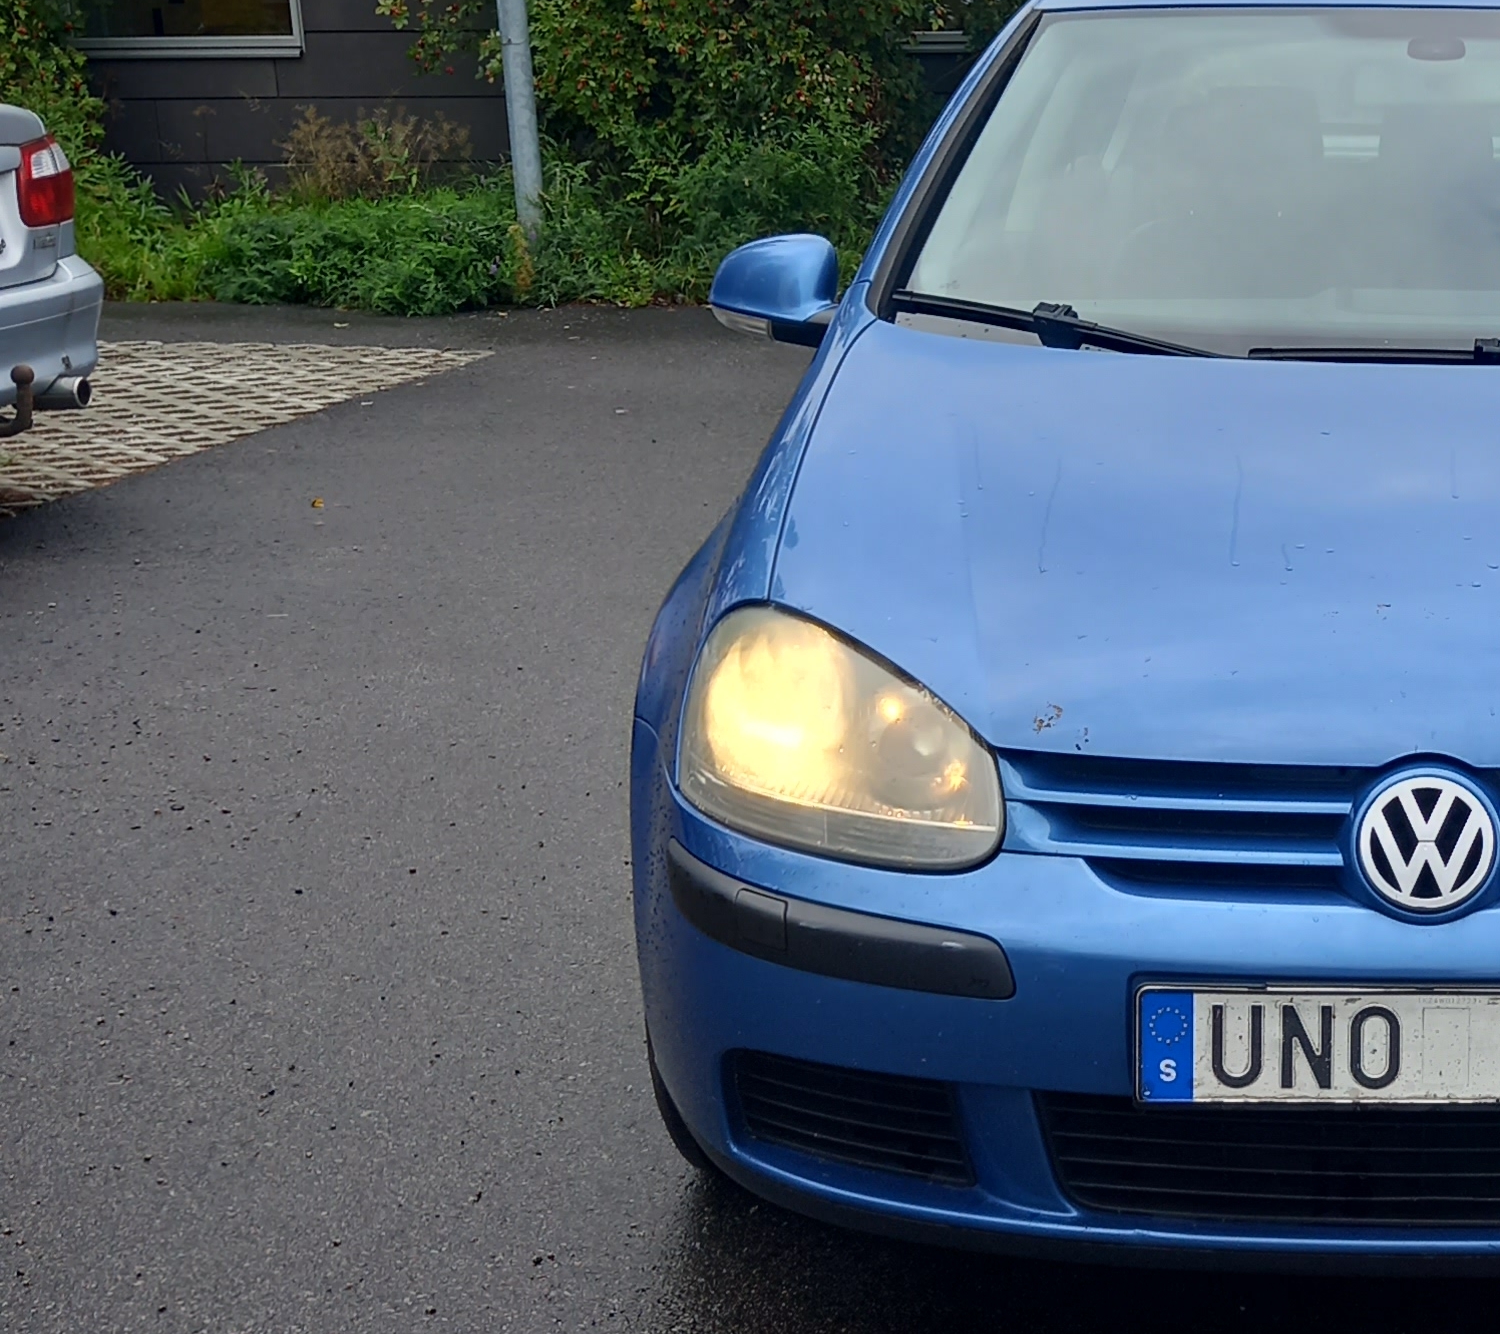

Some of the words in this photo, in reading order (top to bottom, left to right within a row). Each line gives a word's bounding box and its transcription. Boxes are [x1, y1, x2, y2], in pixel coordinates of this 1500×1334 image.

[1361, 778, 1493, 908] VW
[1159, 1058, 1177, 1082] S
[1211, 1004, 1401, 1090] UNO
